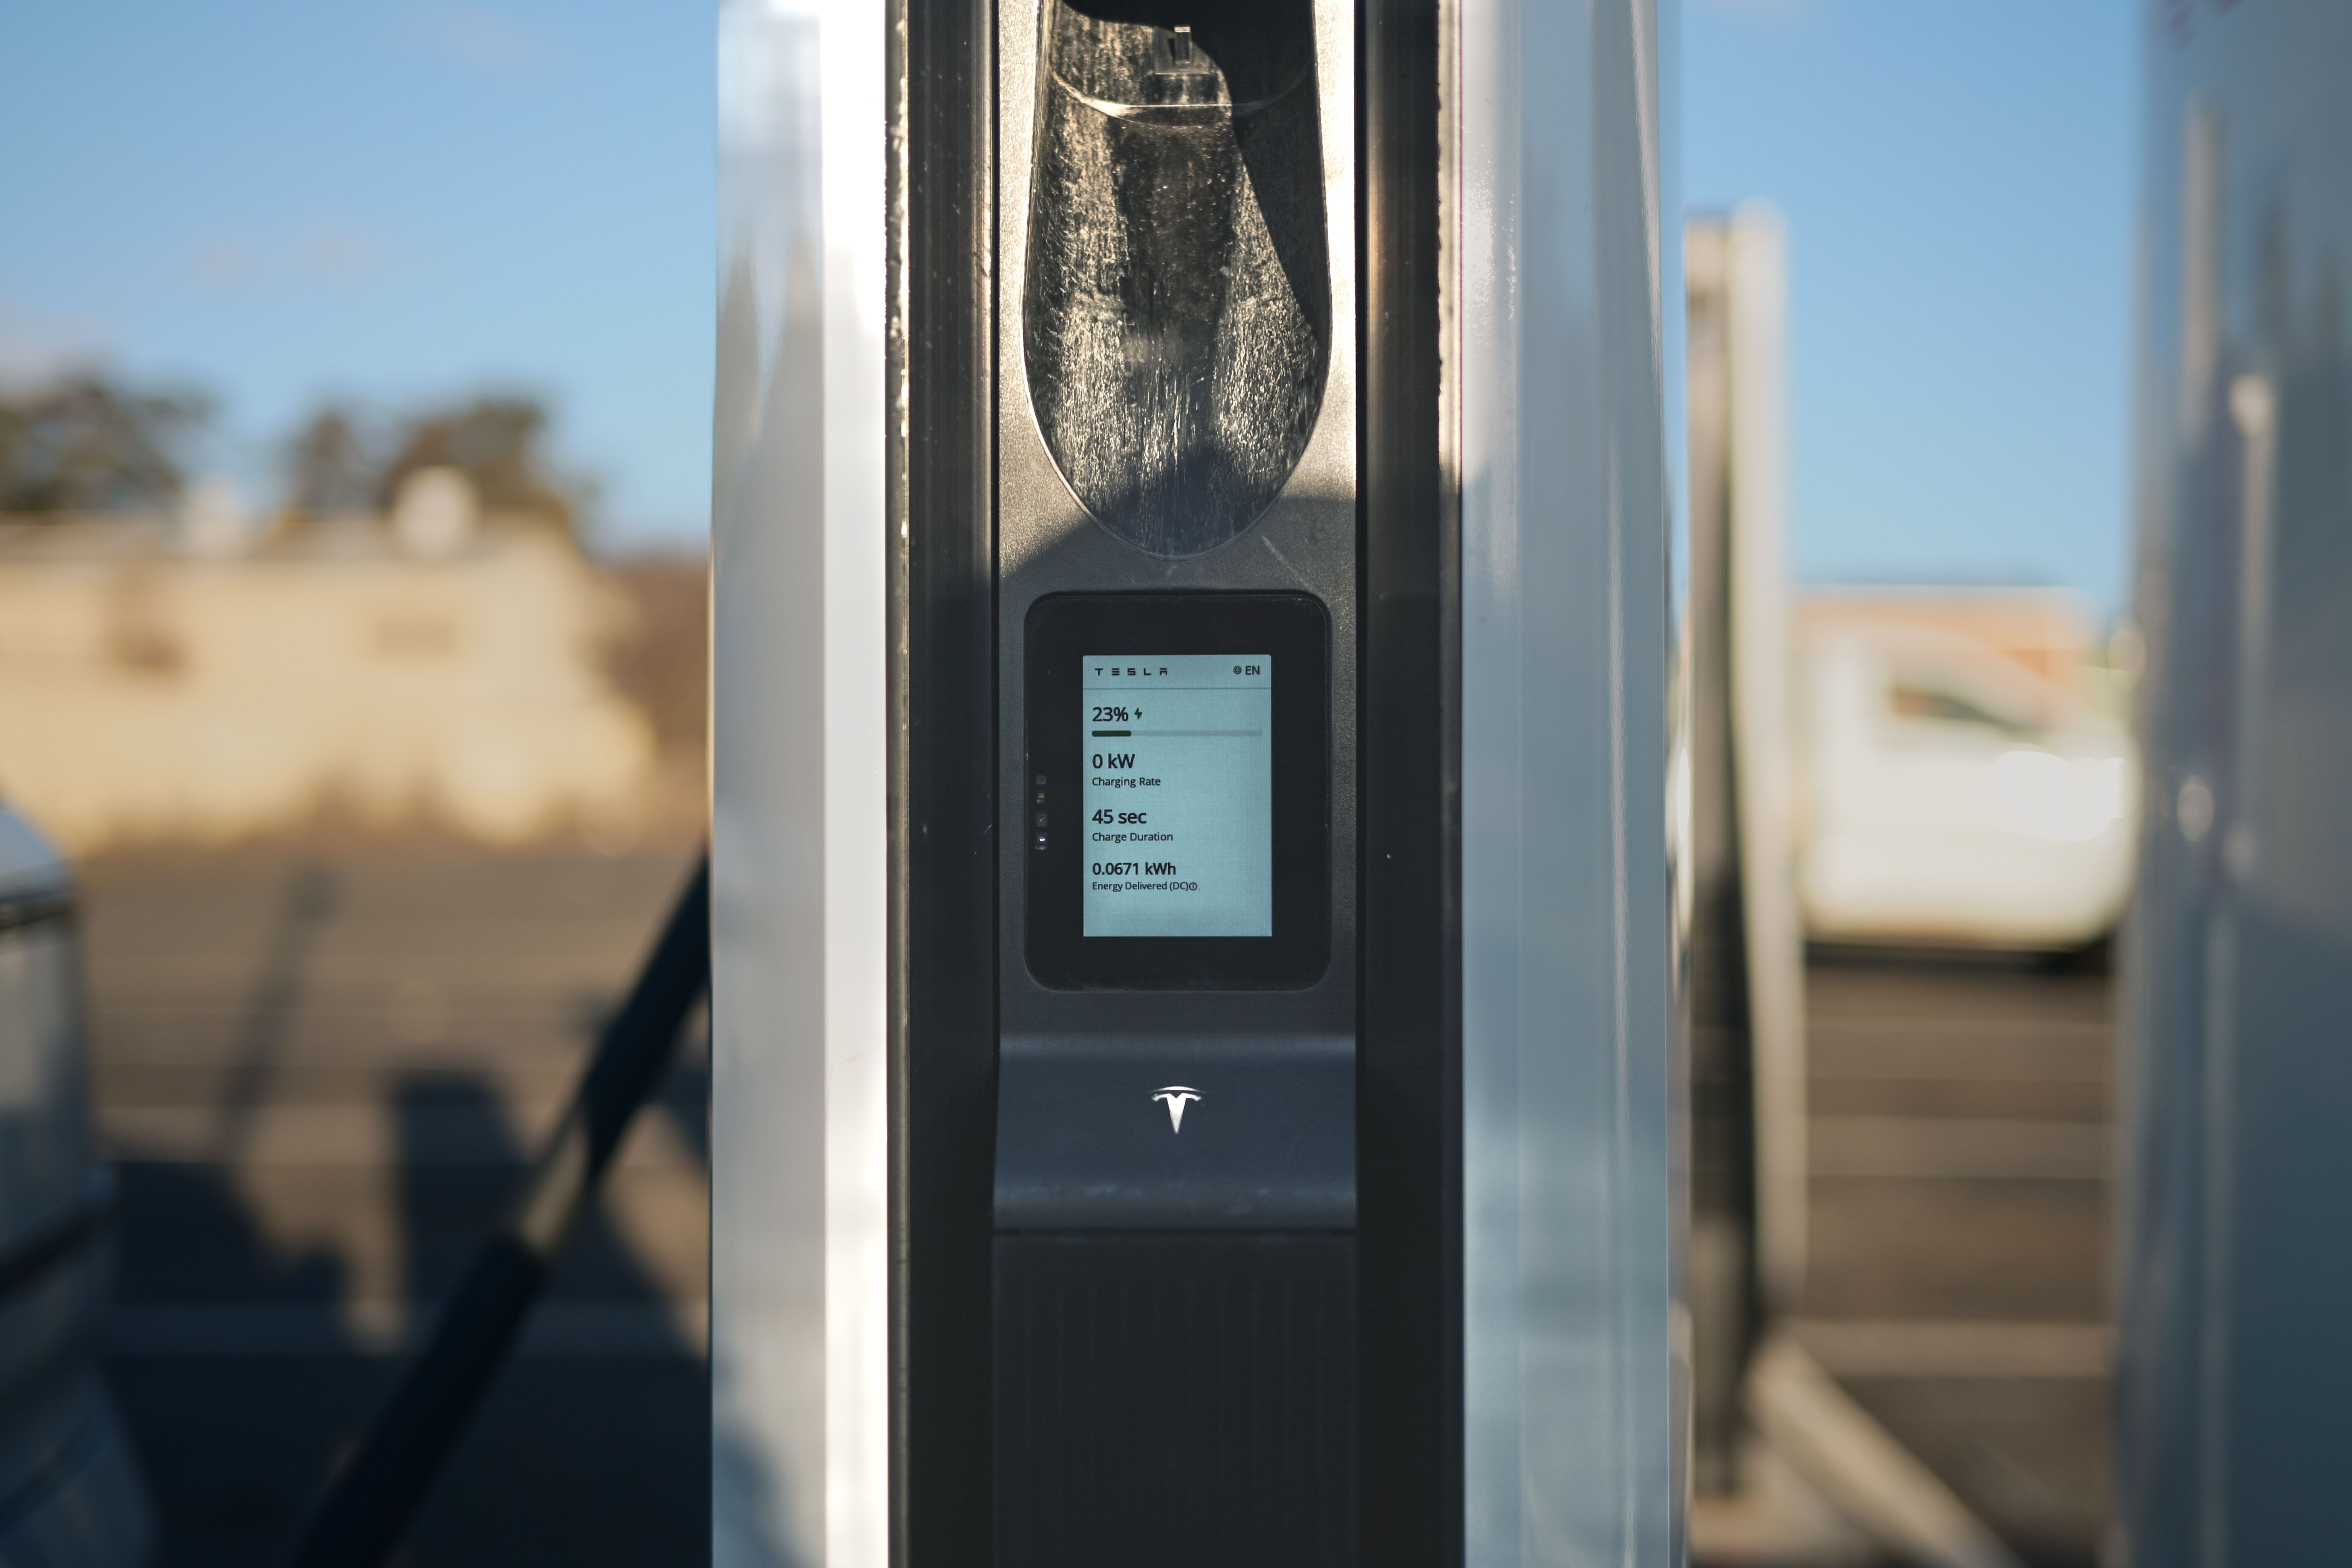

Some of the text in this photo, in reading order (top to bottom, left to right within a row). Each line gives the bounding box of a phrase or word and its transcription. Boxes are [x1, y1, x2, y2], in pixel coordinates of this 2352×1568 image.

[1094, 668, 1168, 676] TESLA
[1245, 665, 1260, 675] EN
[1092, 707, 1129, 722] 23%
[1092, 753, 1135, 769] 0 kW
[1092, 777, 1161, 788] Charging Rate
[1092, 809, 1147, 824] 45 sec
[1092, 832, 1173, 843] Charge Duration
[1092, 862, 1176, 875] 0.0671 kWh
[1092, 882, 1123, 892] Energy
[1125, 881, 1167, 890] Delivered
